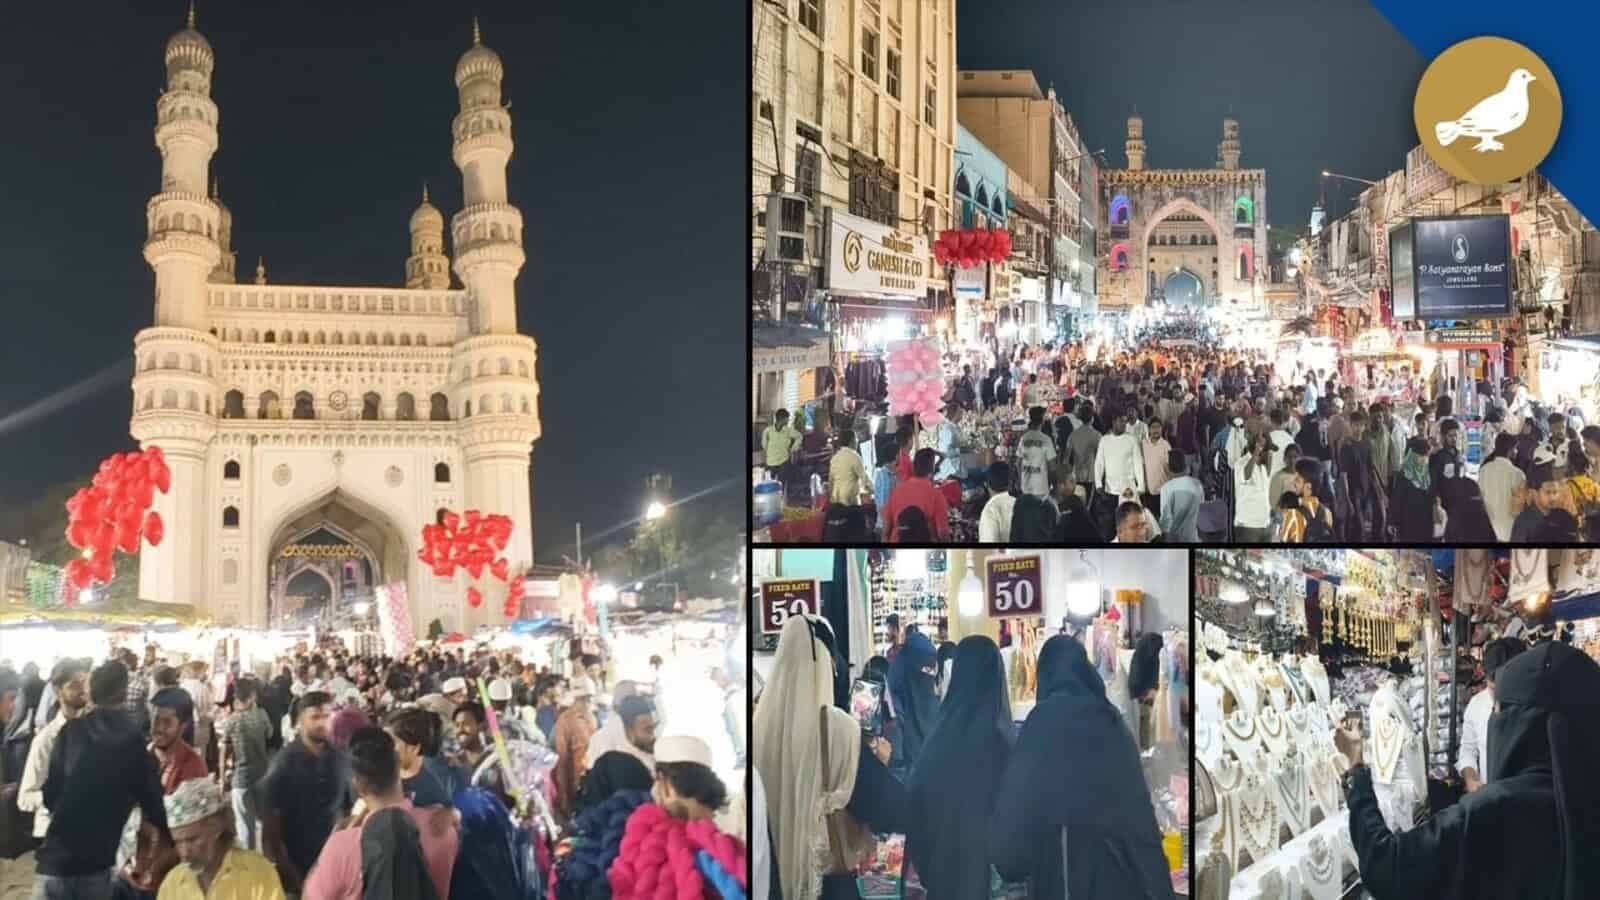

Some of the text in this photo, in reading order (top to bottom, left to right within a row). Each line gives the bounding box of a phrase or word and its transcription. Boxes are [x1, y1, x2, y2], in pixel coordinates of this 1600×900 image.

[867, 250, 923, 277] GANESH & CO
[992, 559, 1035, 572] FIXED RATE
[768, 583, 810, 593] FIXED RATE
[995, 579, 1034, 611] 50
[771, 598, 809, 626] 50
